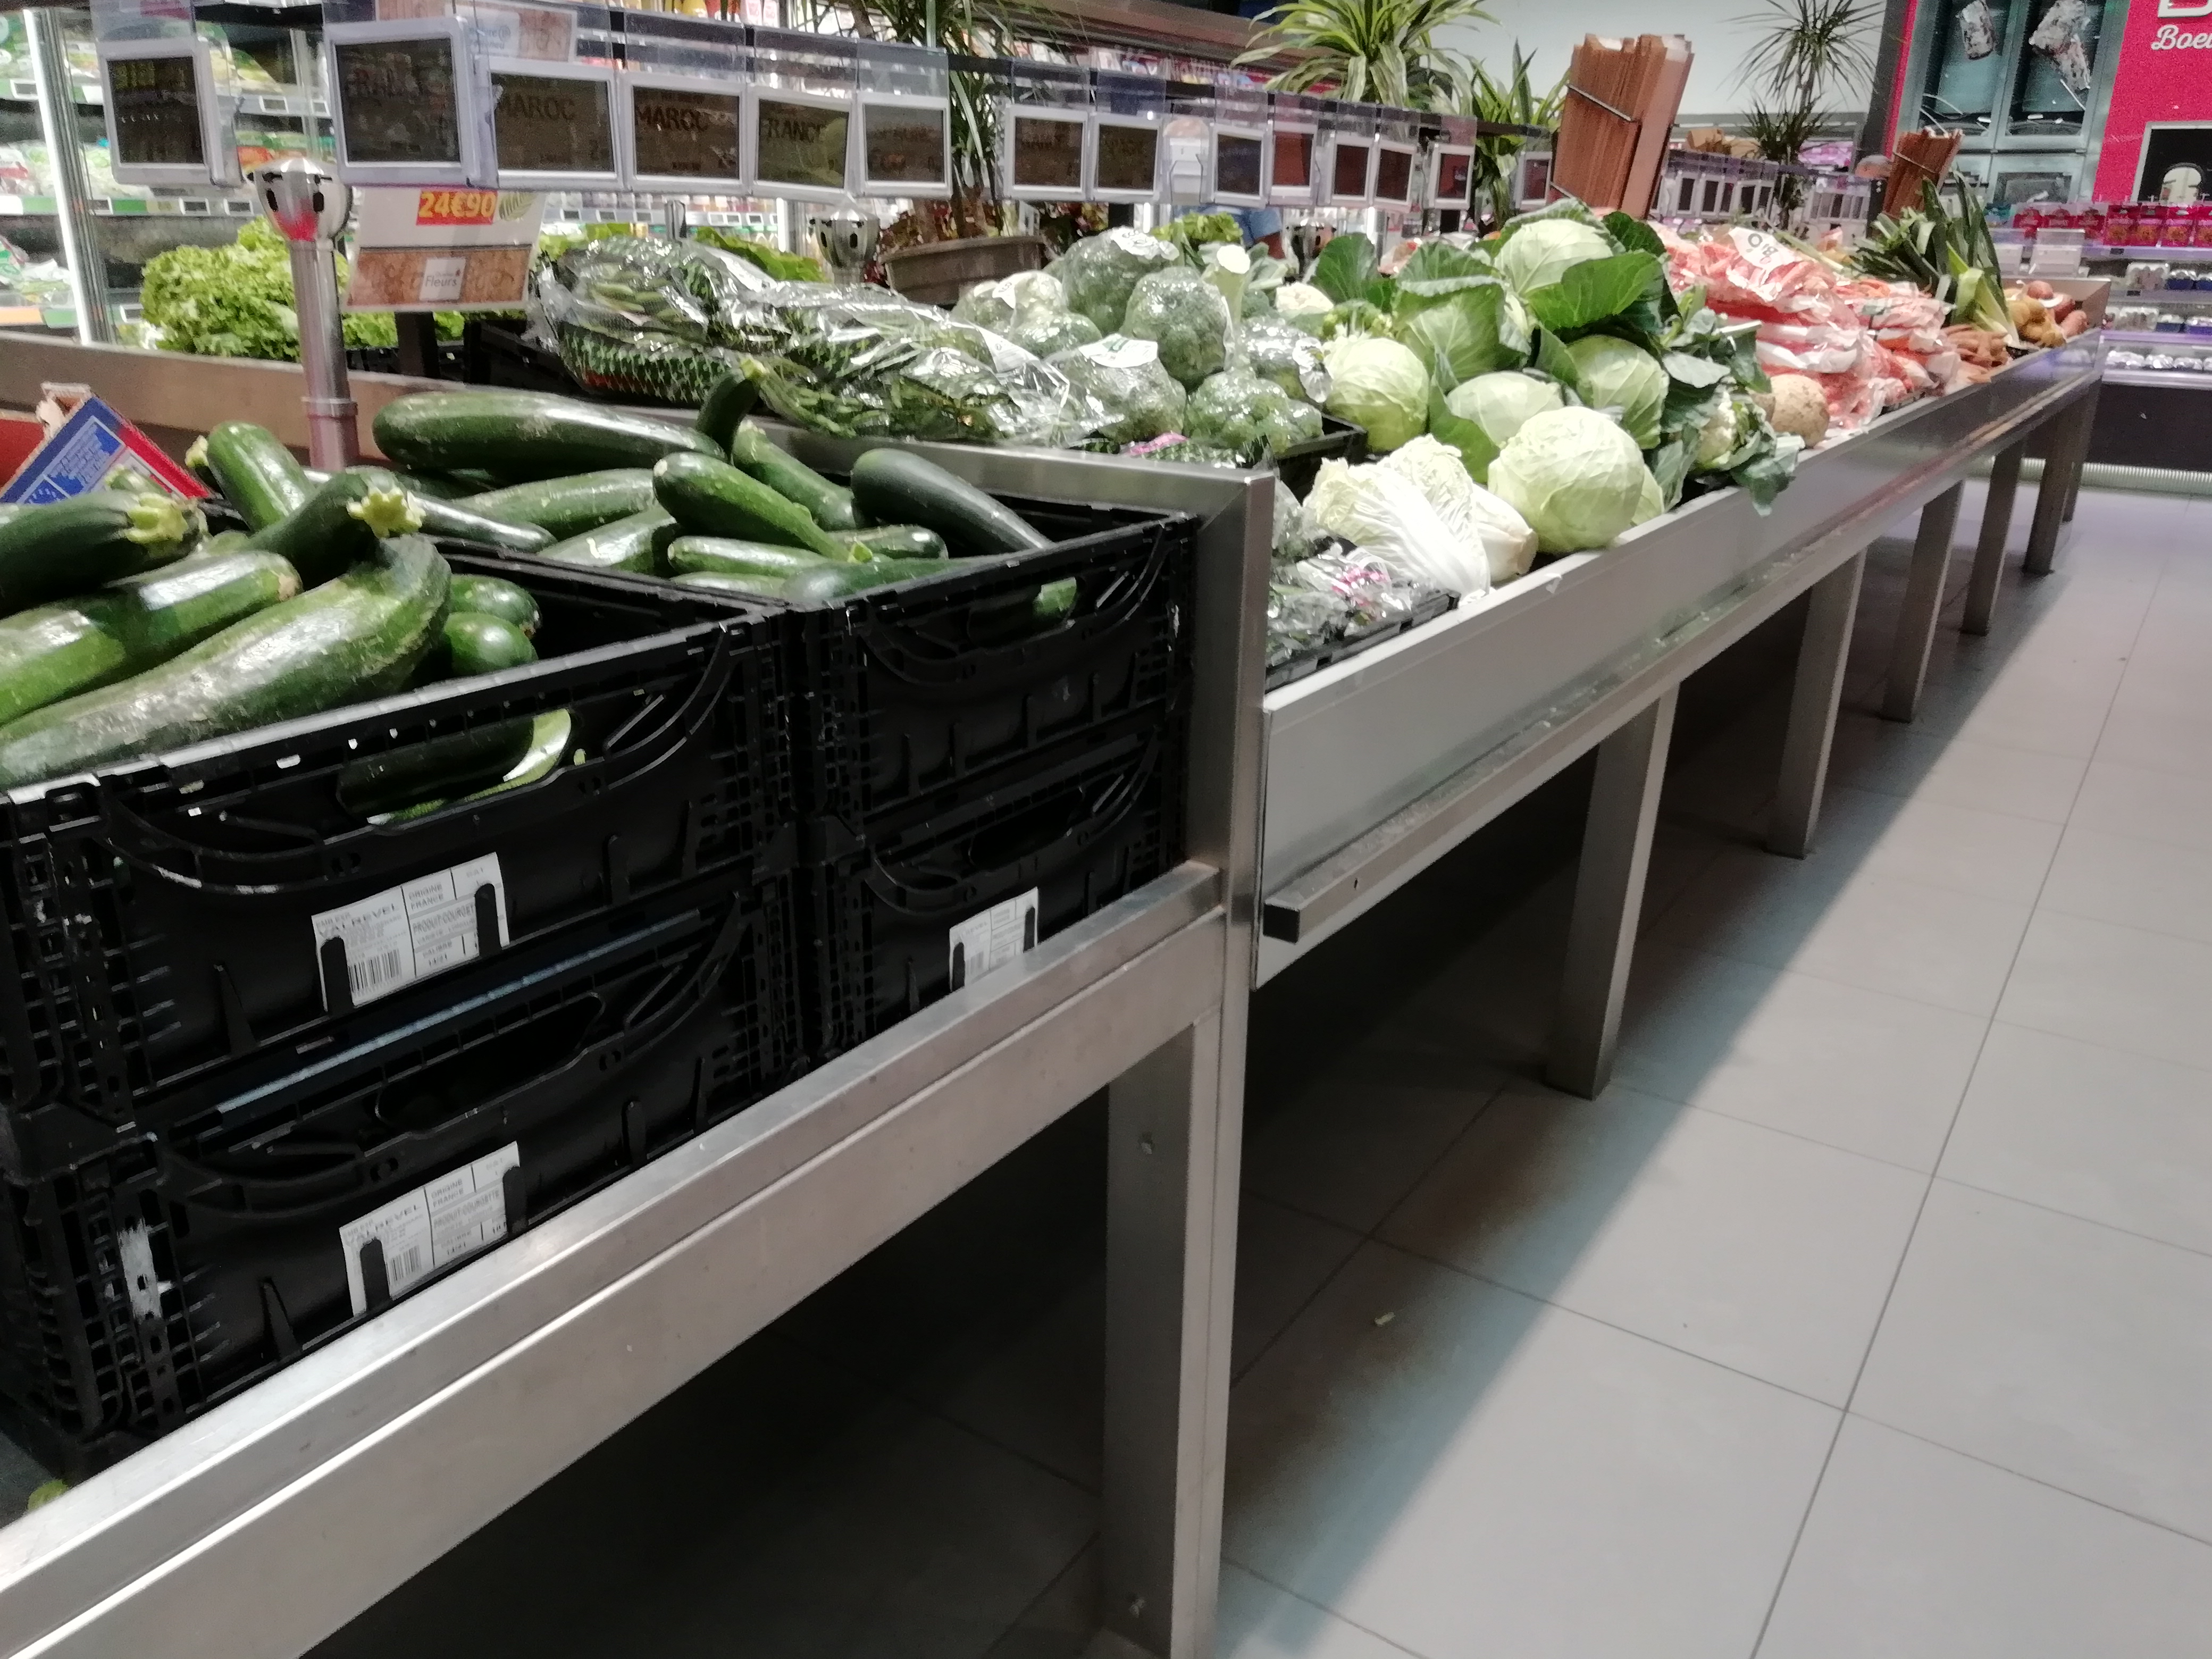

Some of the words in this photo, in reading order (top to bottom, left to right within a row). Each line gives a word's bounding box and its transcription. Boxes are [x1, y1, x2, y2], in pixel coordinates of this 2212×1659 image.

[425, 275, 457, 287] Fleurs
[431, 1178, 463, 1199] ORIGINE
[433, 1188, 464, 1208] FRANCE
